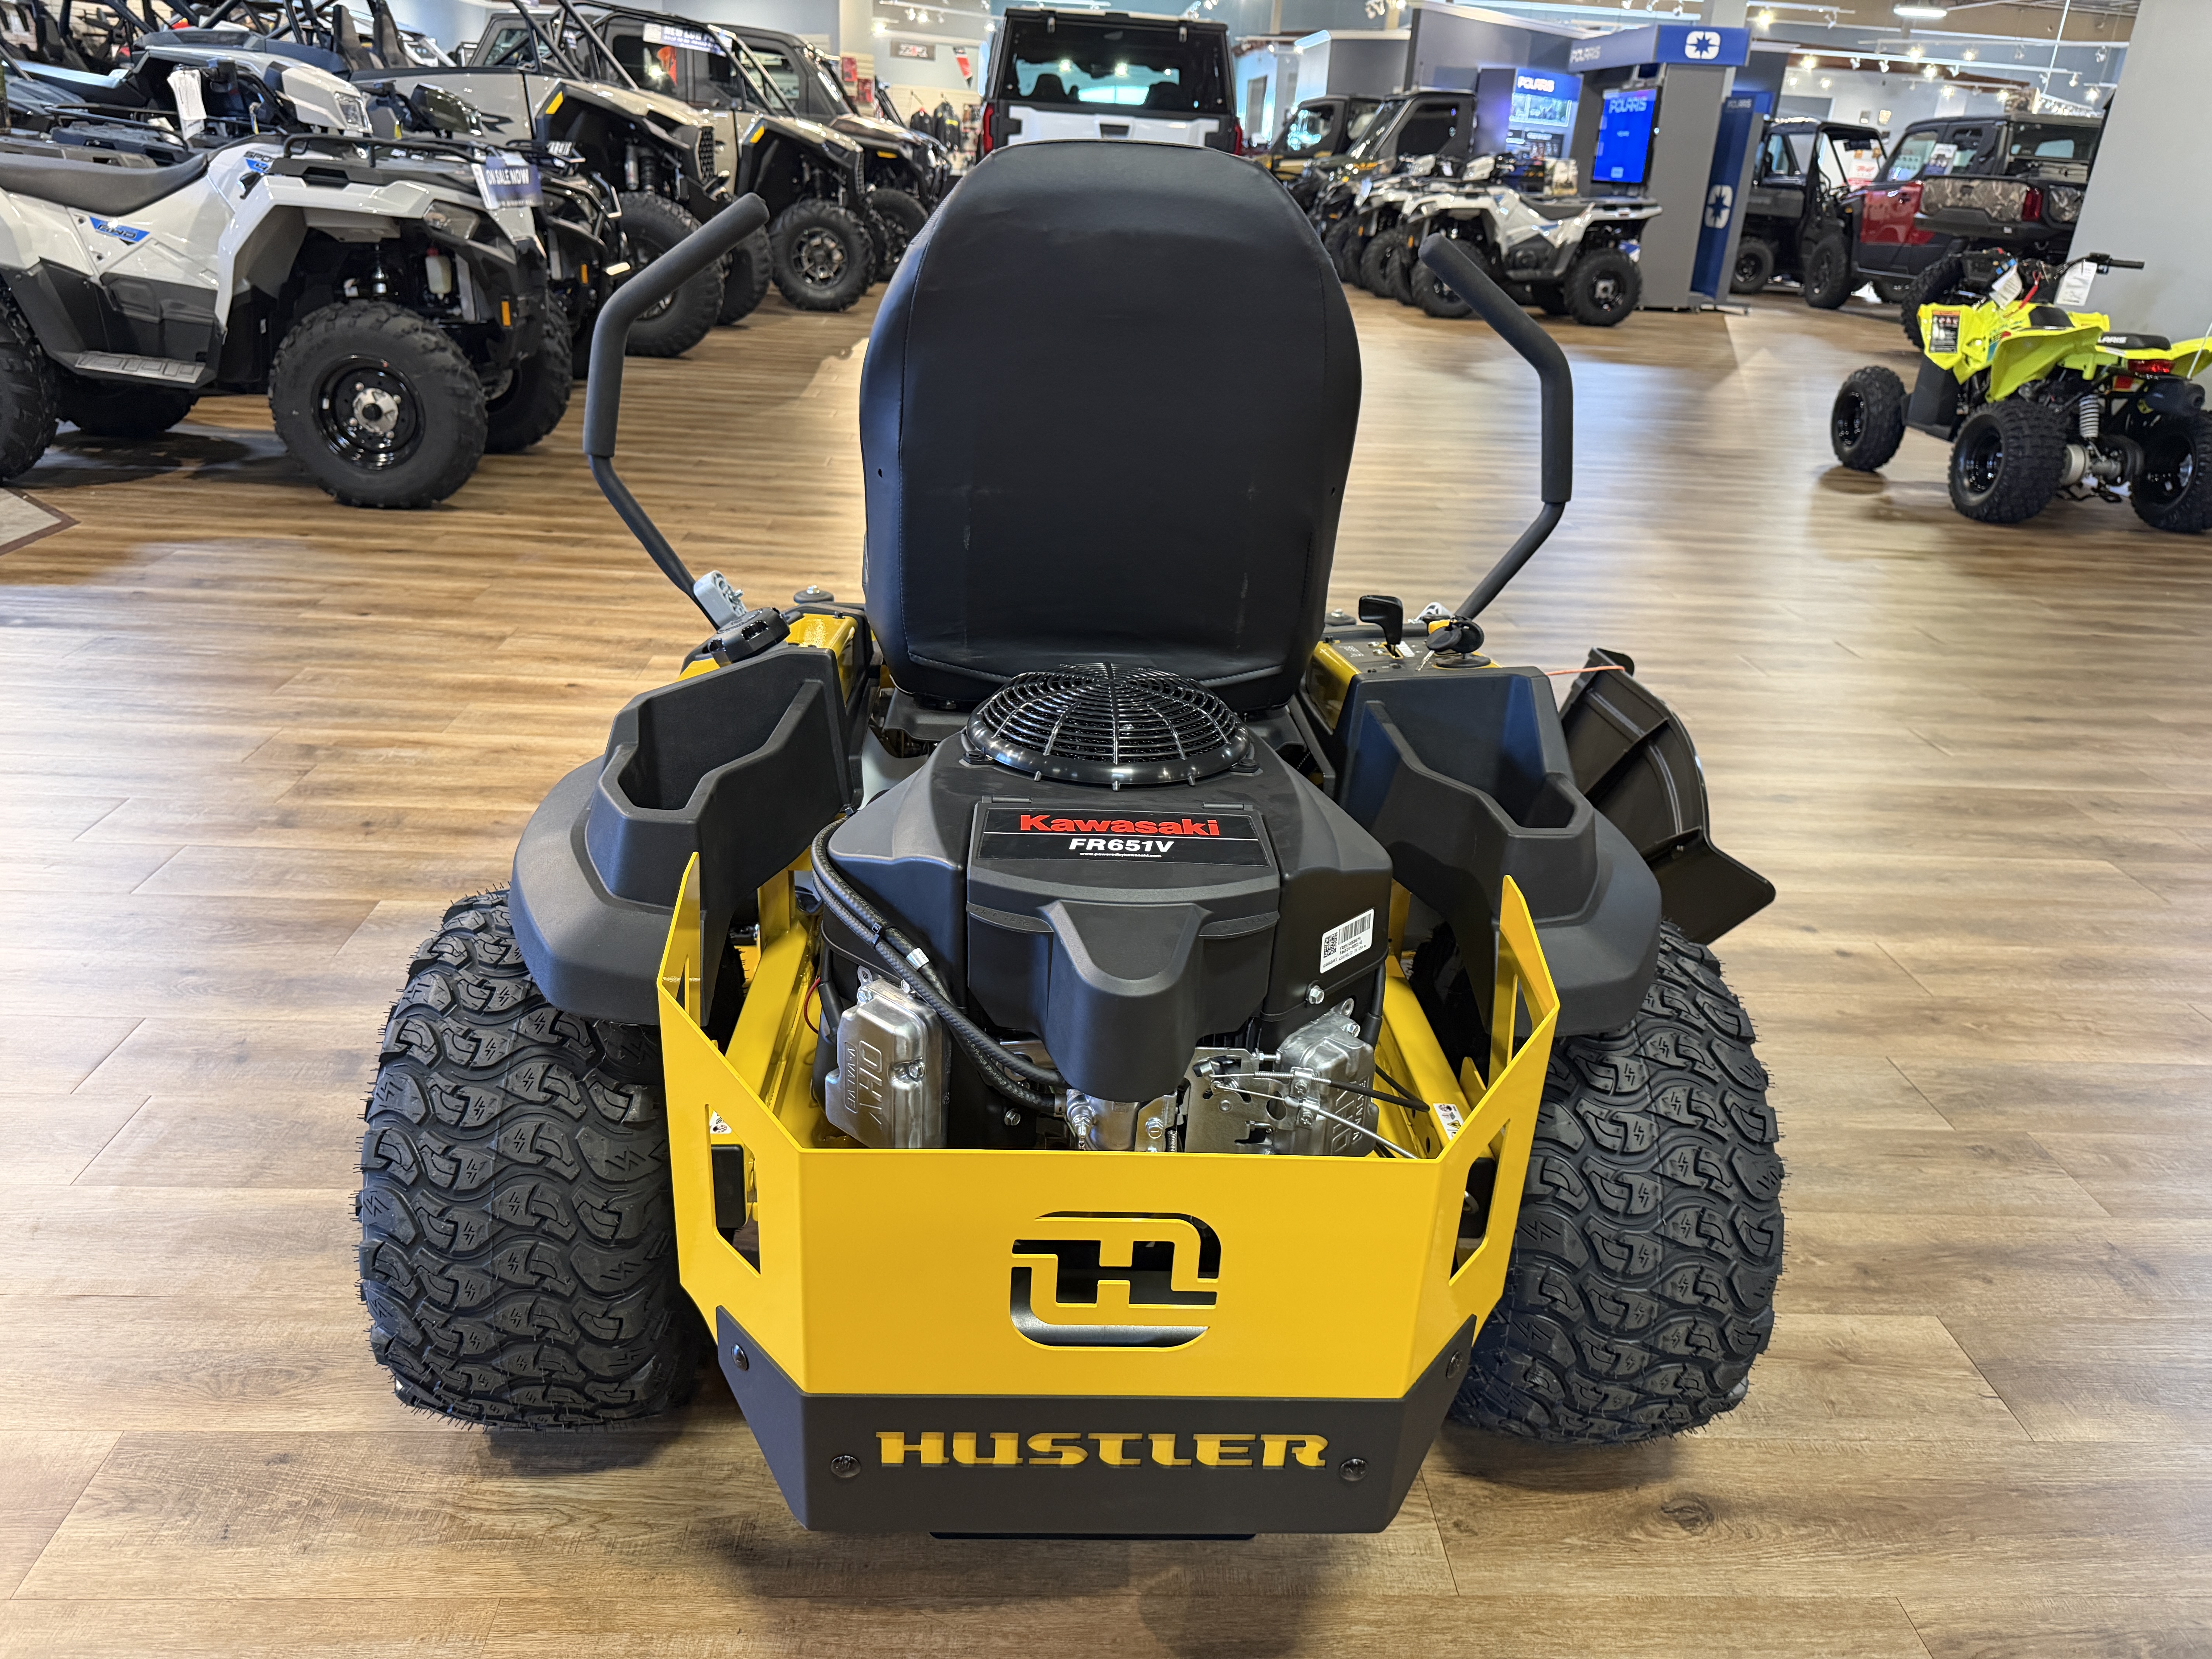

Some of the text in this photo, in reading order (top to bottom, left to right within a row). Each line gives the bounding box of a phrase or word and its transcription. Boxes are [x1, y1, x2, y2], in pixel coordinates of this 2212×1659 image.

[1517, 76, 1555, 93] POLARIS
[1608, 96, 1647, 114] POLARIS
[486, 168, 529, 185] ON SALE NOW
[1020, 814, 1220, 836] Kawasaki
[1069, 838, 1174, 852] FR651V
[847, 1048, 855, 1109] V-VALVE
[859, 1040, 882, 1131] OHV
[876, 1431, 1328, 1468] HUSTLER
